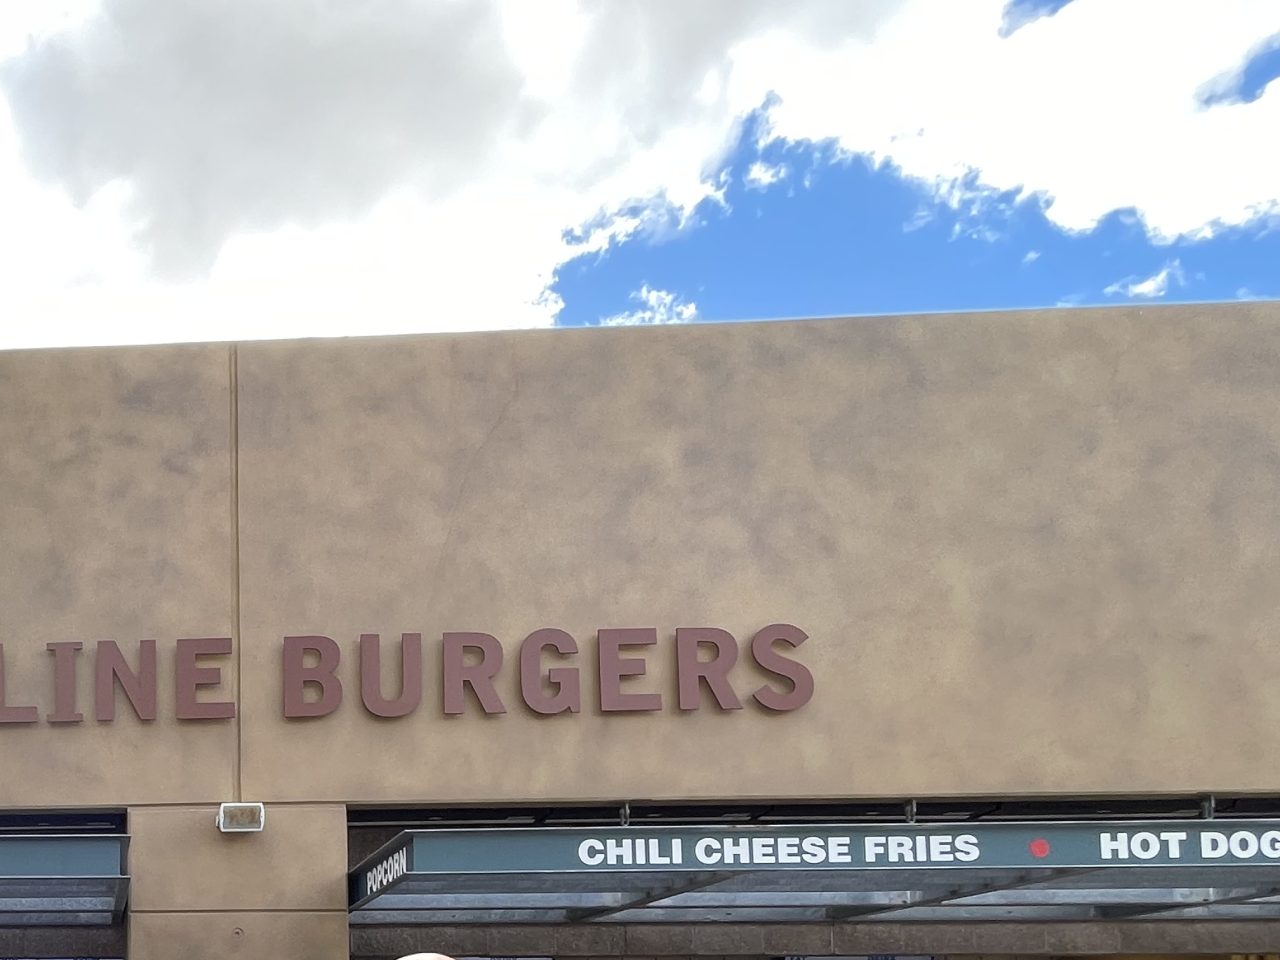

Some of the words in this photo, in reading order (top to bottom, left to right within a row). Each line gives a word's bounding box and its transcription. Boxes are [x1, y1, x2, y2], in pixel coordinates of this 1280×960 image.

[282, 623, 815, 718] BURGERS
[578, 838, 683, 866] CHILI
[694, 836, 852, 865] CHEESE
[864, 834, 980, 863] FRIES
[1099, 831, 1188, 860] HOT
[366, 847, 407, 896] POPCORN
